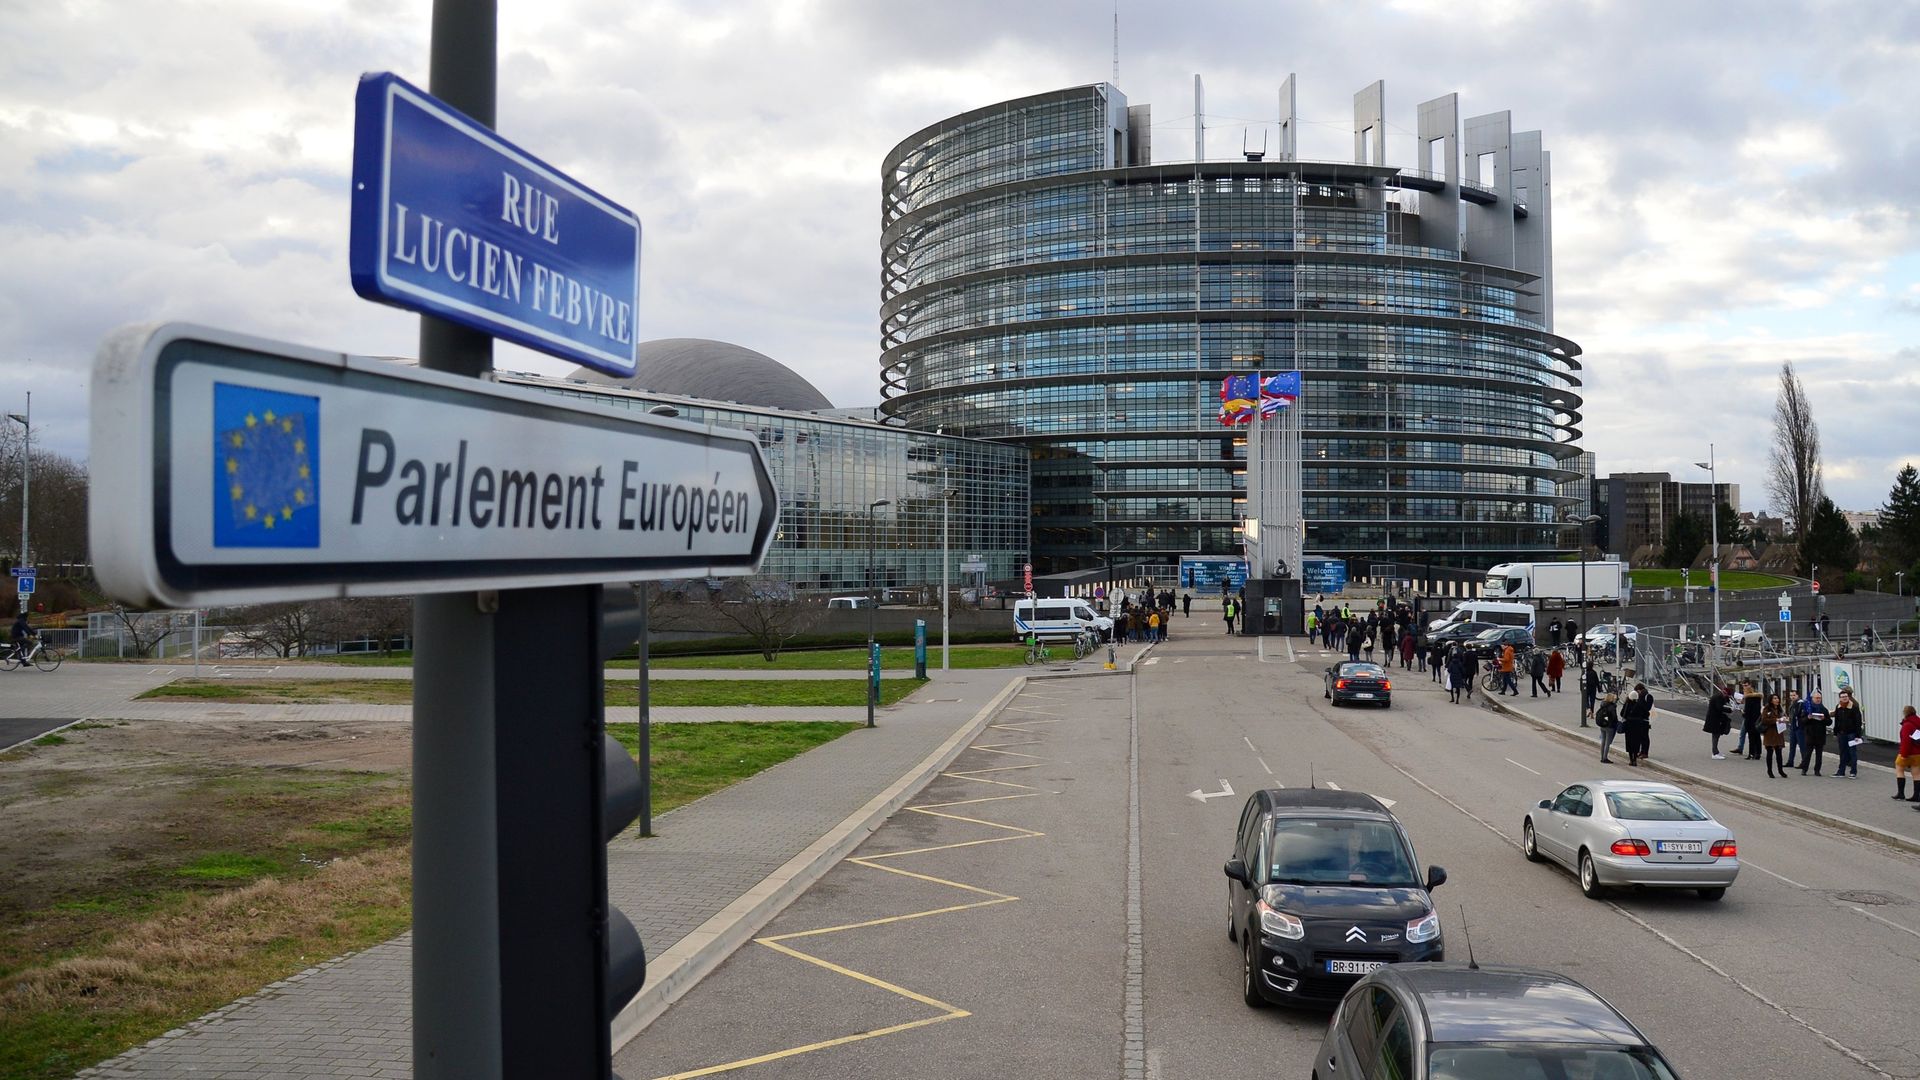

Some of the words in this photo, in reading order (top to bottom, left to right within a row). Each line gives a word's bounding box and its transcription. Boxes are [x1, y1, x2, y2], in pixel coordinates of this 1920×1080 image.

[501, 171, 559, 244] RUE
[393, 202, 523, 304] LUCIEN
[531, 262, 631, 345] FEBVRE
[350, 428, 605, 530] Parlement
[618, 460, 749, 550] Européen
